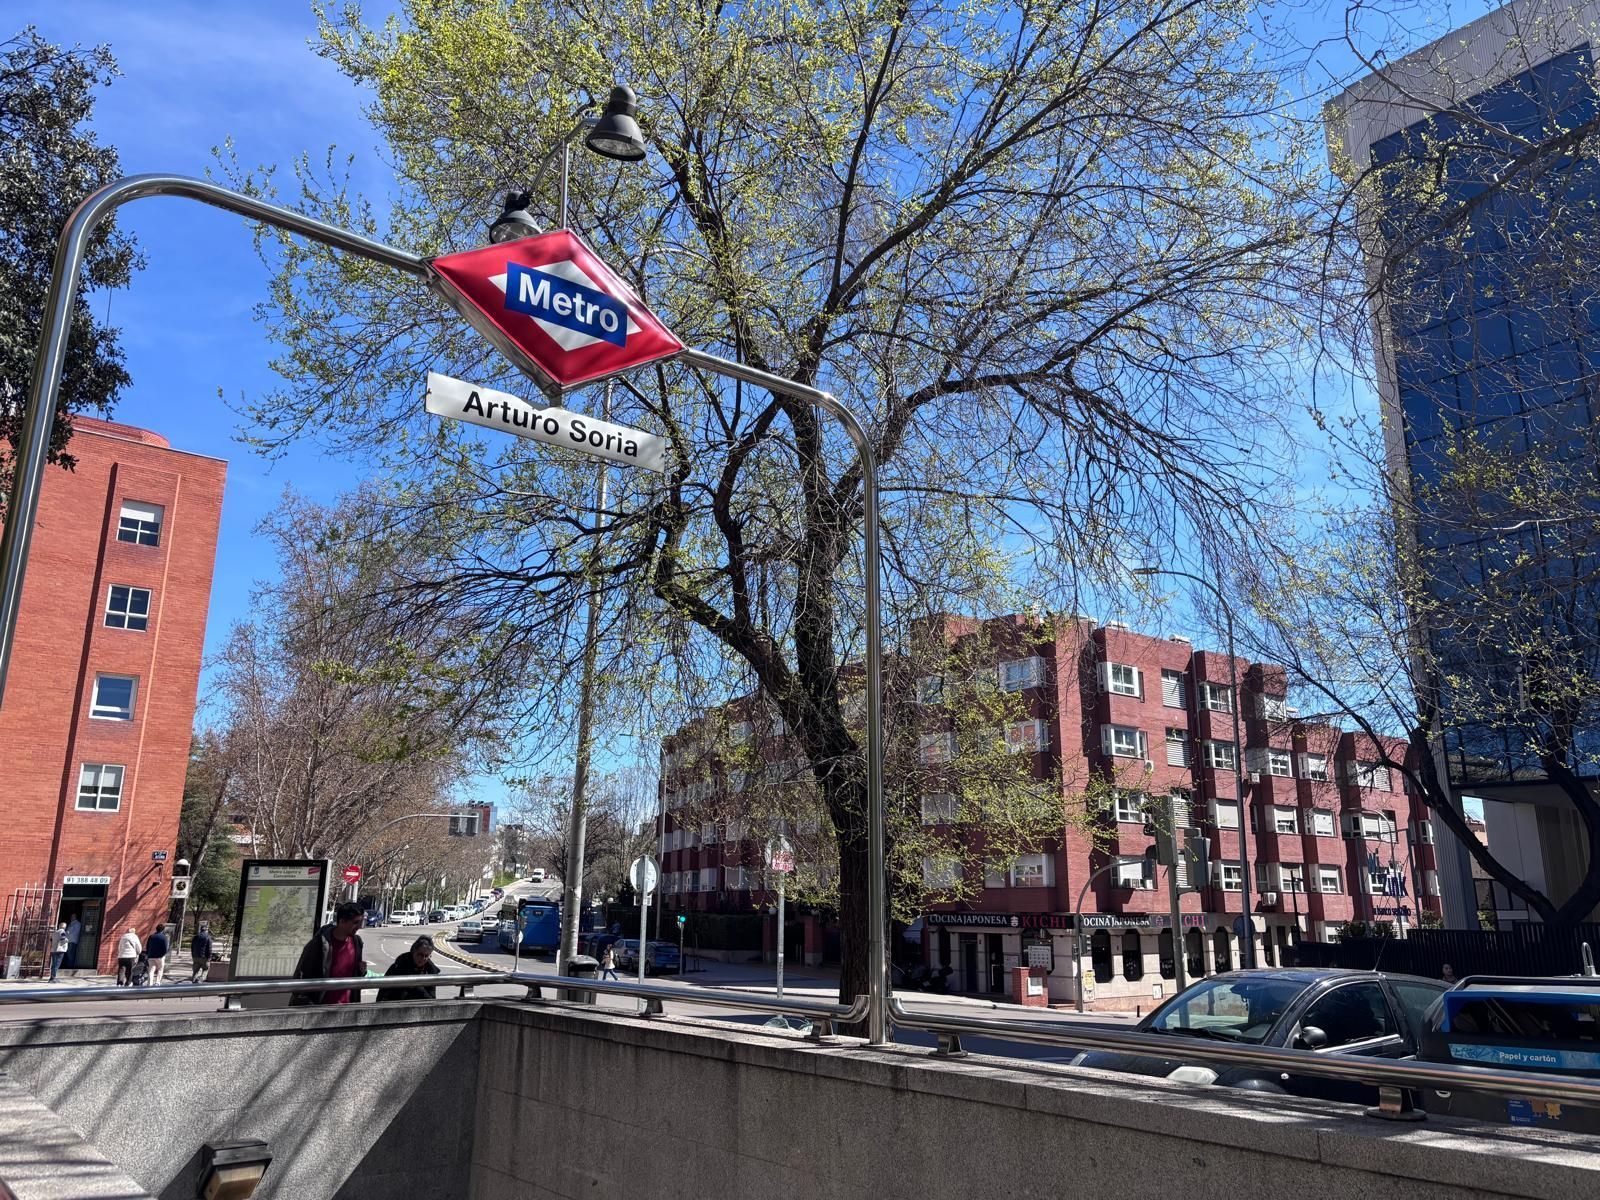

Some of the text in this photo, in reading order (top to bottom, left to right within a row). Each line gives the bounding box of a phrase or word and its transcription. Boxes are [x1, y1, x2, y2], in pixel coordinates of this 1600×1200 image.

[518, 272, 619, 333] Metro
[462, 391, 638, 457] Arturo Soria
[929, 914, 1007, 925] COCINA JAPONESA
[1022, 915, 1067, 928] KICHI
[1083, 917, 1111, 927] OCINA
[1499, 1051, 1521, 1061] Papel
[1530, 1054, 1557, 1063] cartón
